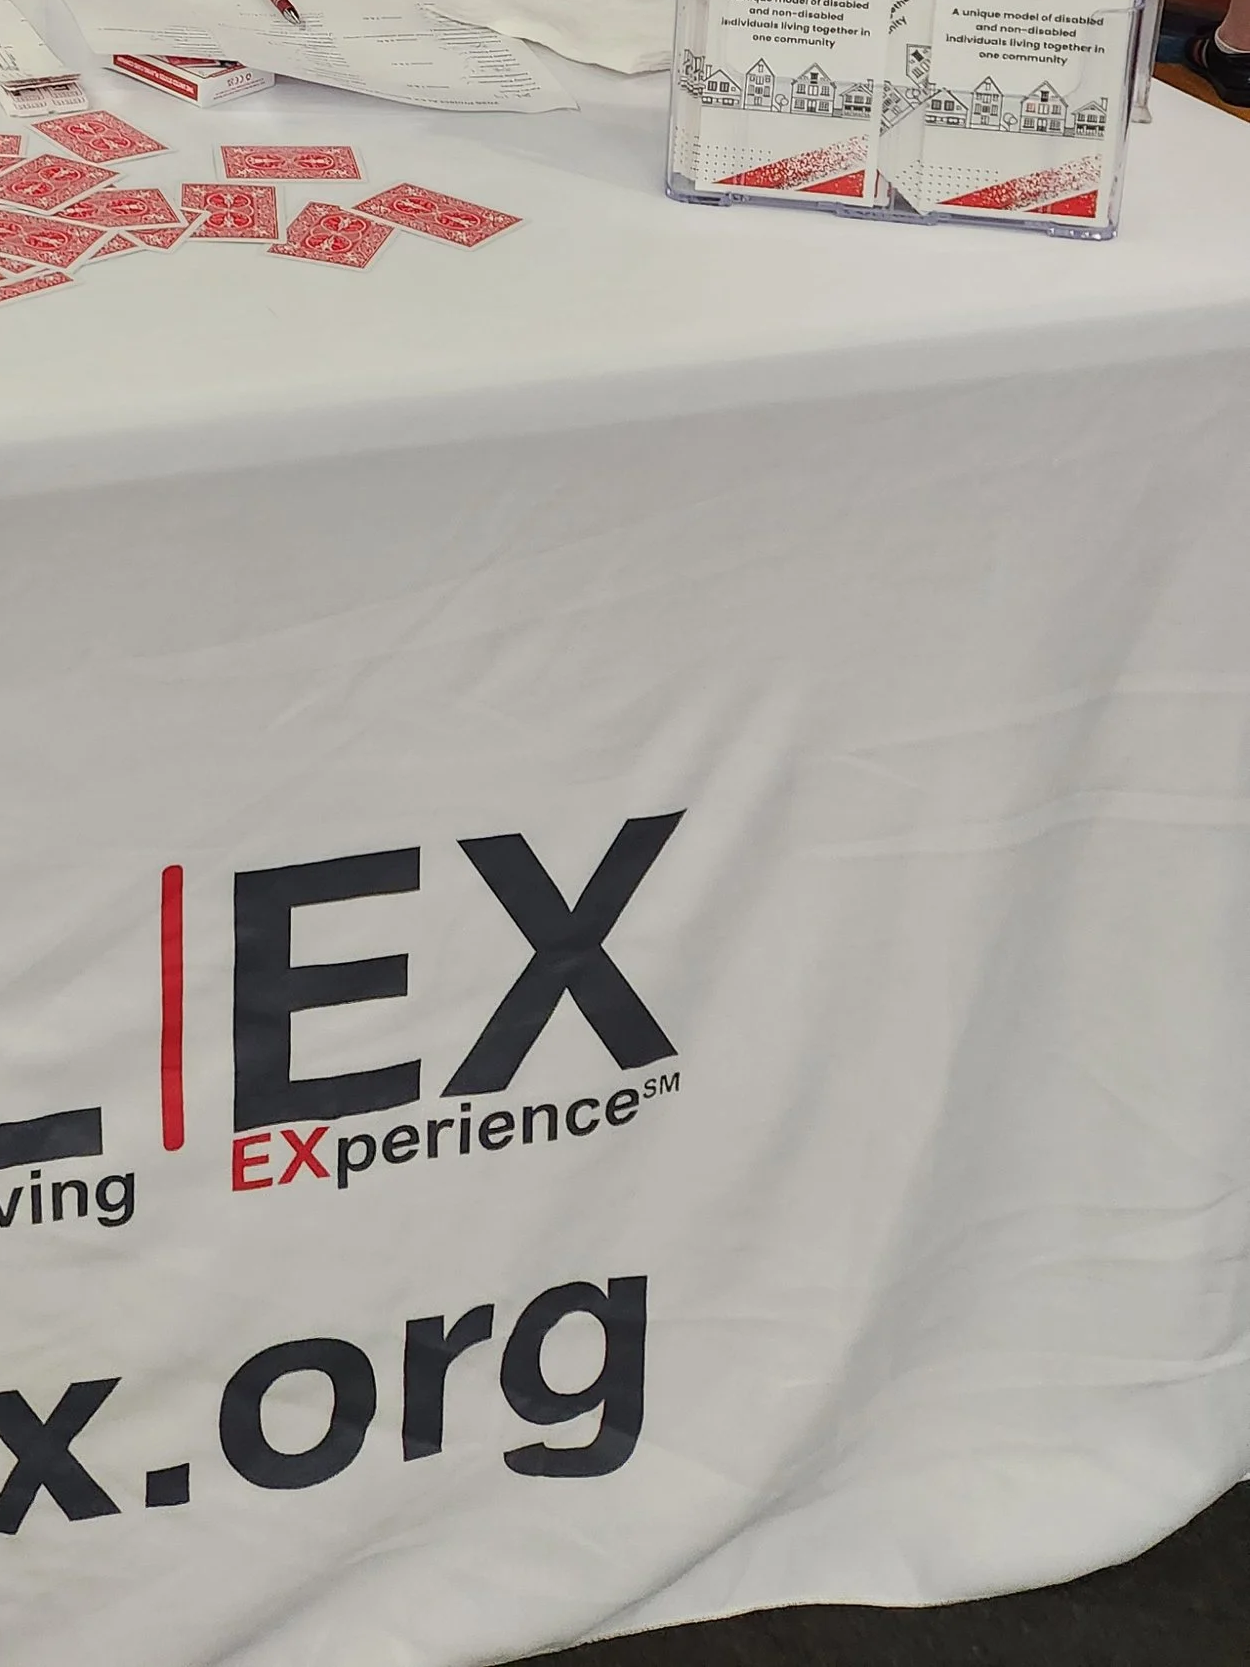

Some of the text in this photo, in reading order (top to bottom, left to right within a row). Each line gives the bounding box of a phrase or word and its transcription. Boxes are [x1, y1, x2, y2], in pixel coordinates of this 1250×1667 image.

[823, 0, 869, 10] disabled
[749, 7, 844, 21] and non-disabled
[952, 8, 1104, 26] A unique model of disabled
[721, 17, 871, 37] individuals living together in
[975, 23, 1077, 37] and non-disabled
[752, 34, 836, 49] one community
[946, 34, 1105, 54] individuals living together in
[978, 51, 1068, 66] one community
